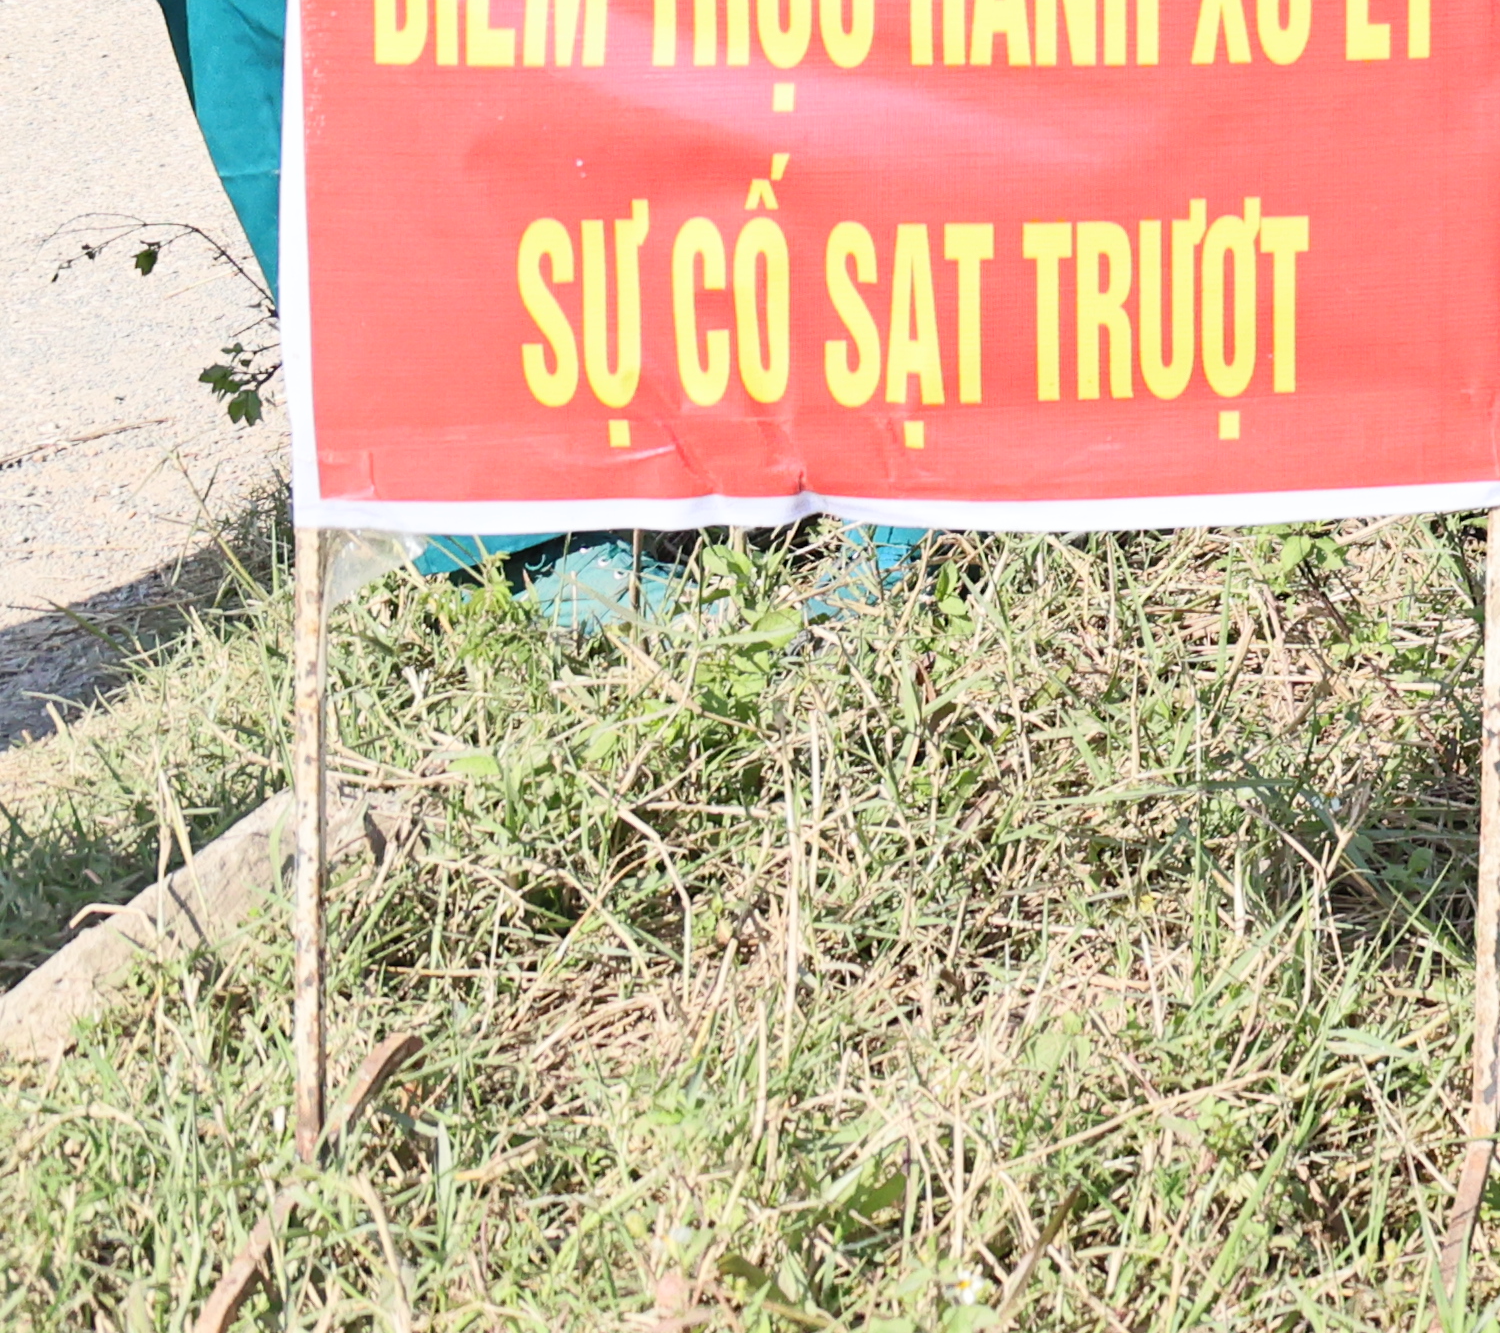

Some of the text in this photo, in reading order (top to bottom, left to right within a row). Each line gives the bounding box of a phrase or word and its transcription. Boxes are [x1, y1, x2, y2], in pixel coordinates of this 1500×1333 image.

[516, 152, 1310, 450] SỰ CỐ SẠT TRƯỢT
